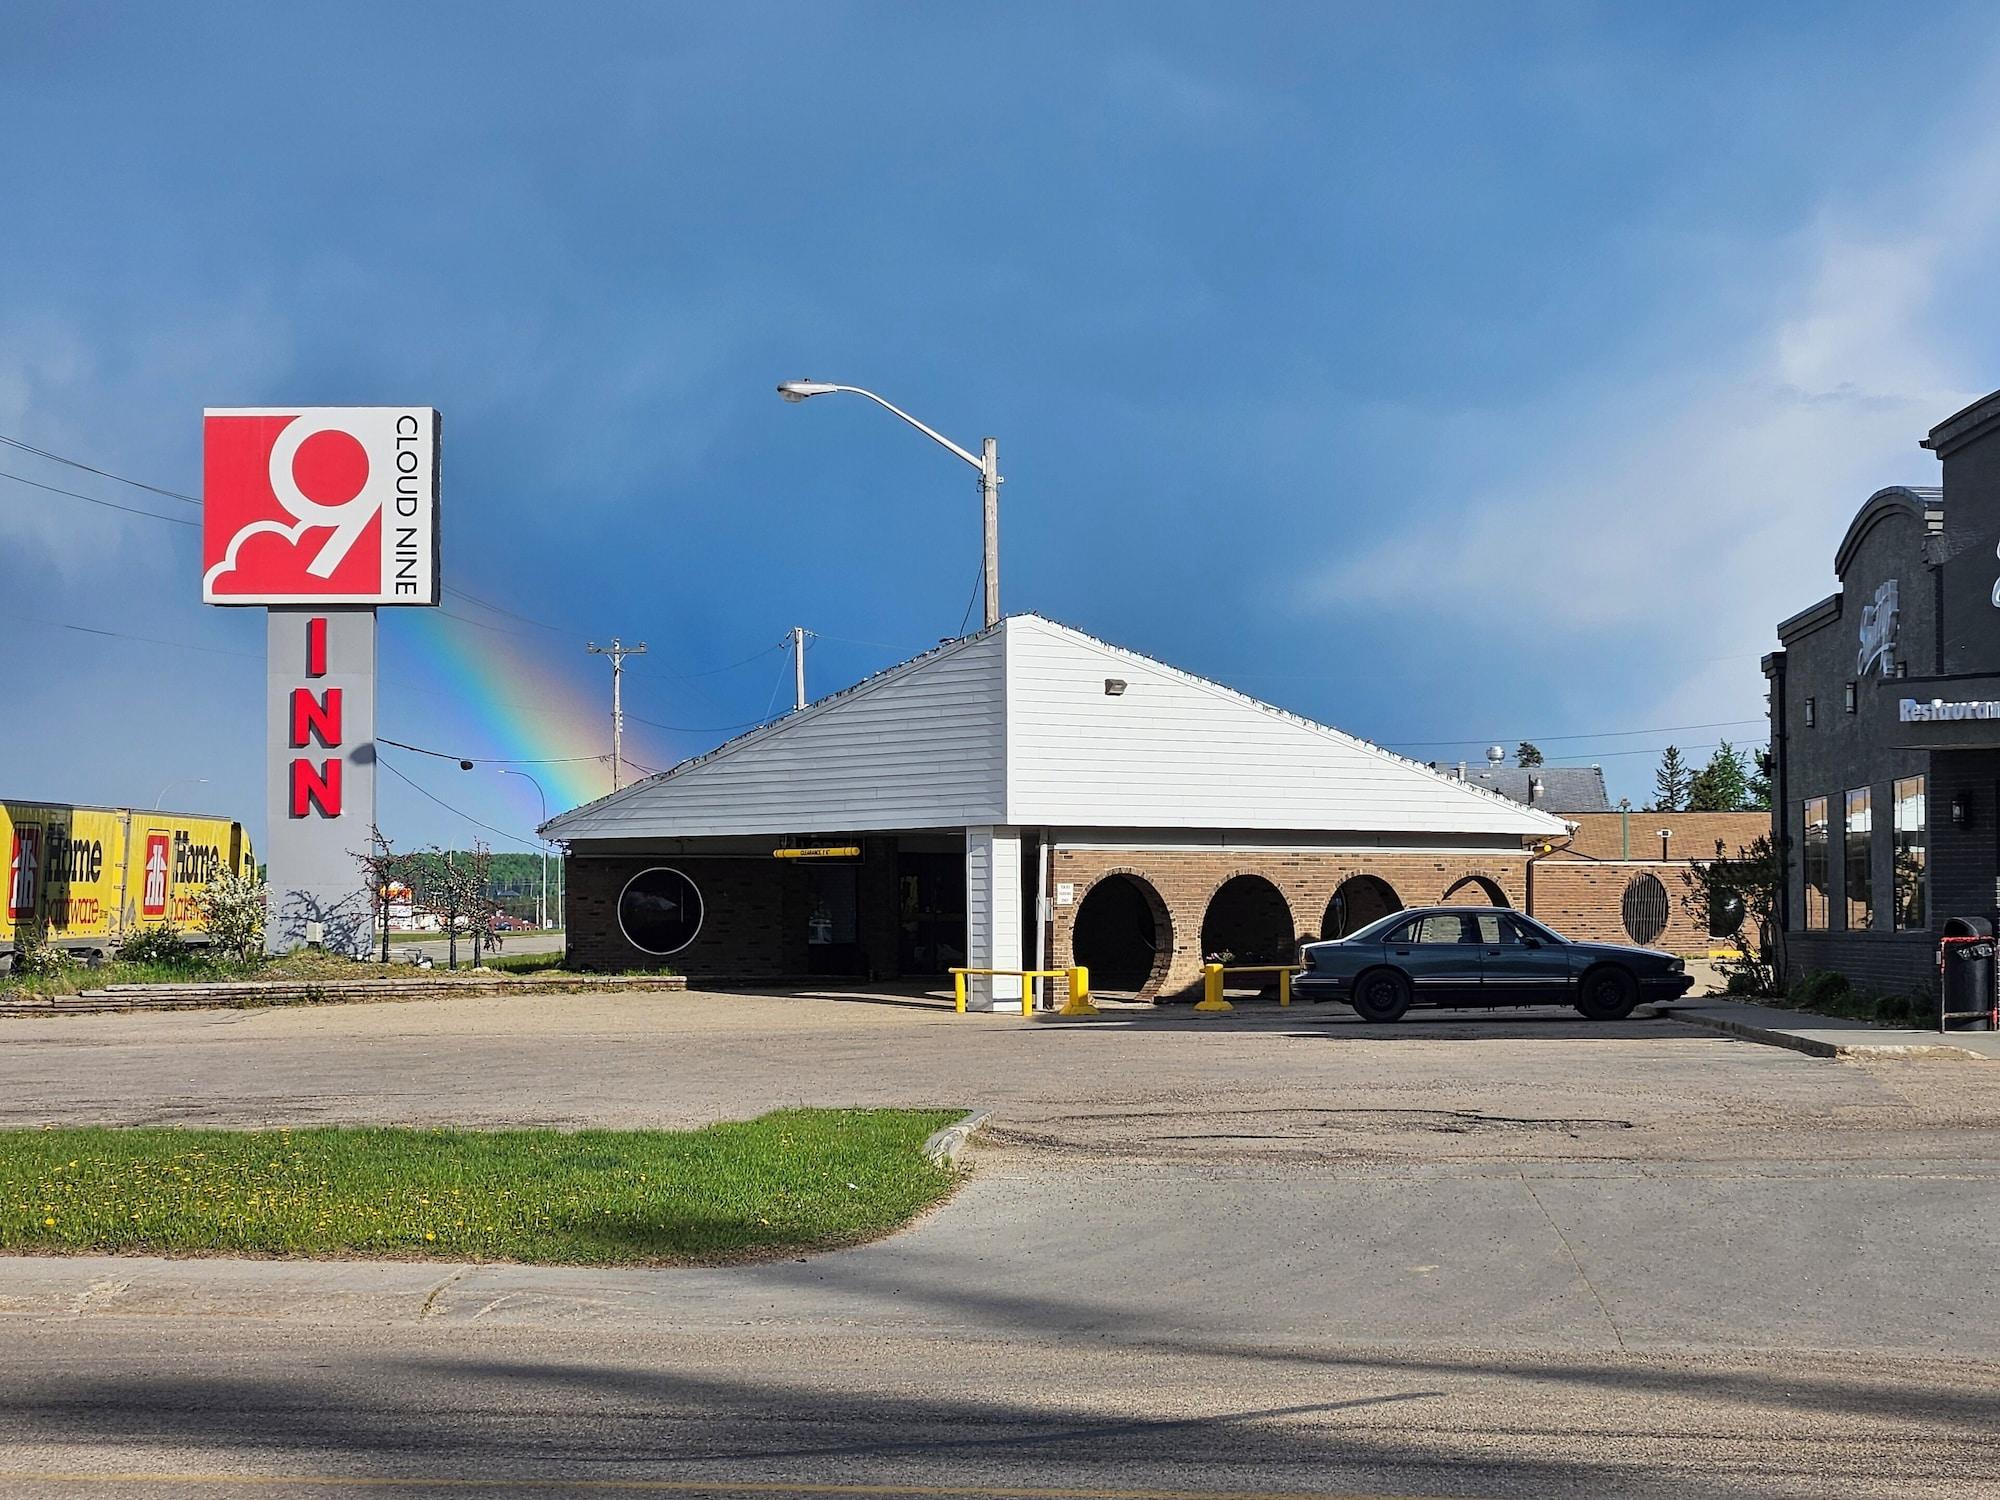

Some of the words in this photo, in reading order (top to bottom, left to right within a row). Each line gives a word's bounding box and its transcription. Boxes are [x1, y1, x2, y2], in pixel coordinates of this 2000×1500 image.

[396, 415, 418, 517] CLOUD
[395, 528, 417, 595] NINE
[289, 617, 343, 819] INN
[46, 822, 102, 883] Home
[174, 830, 219, 884] Home
